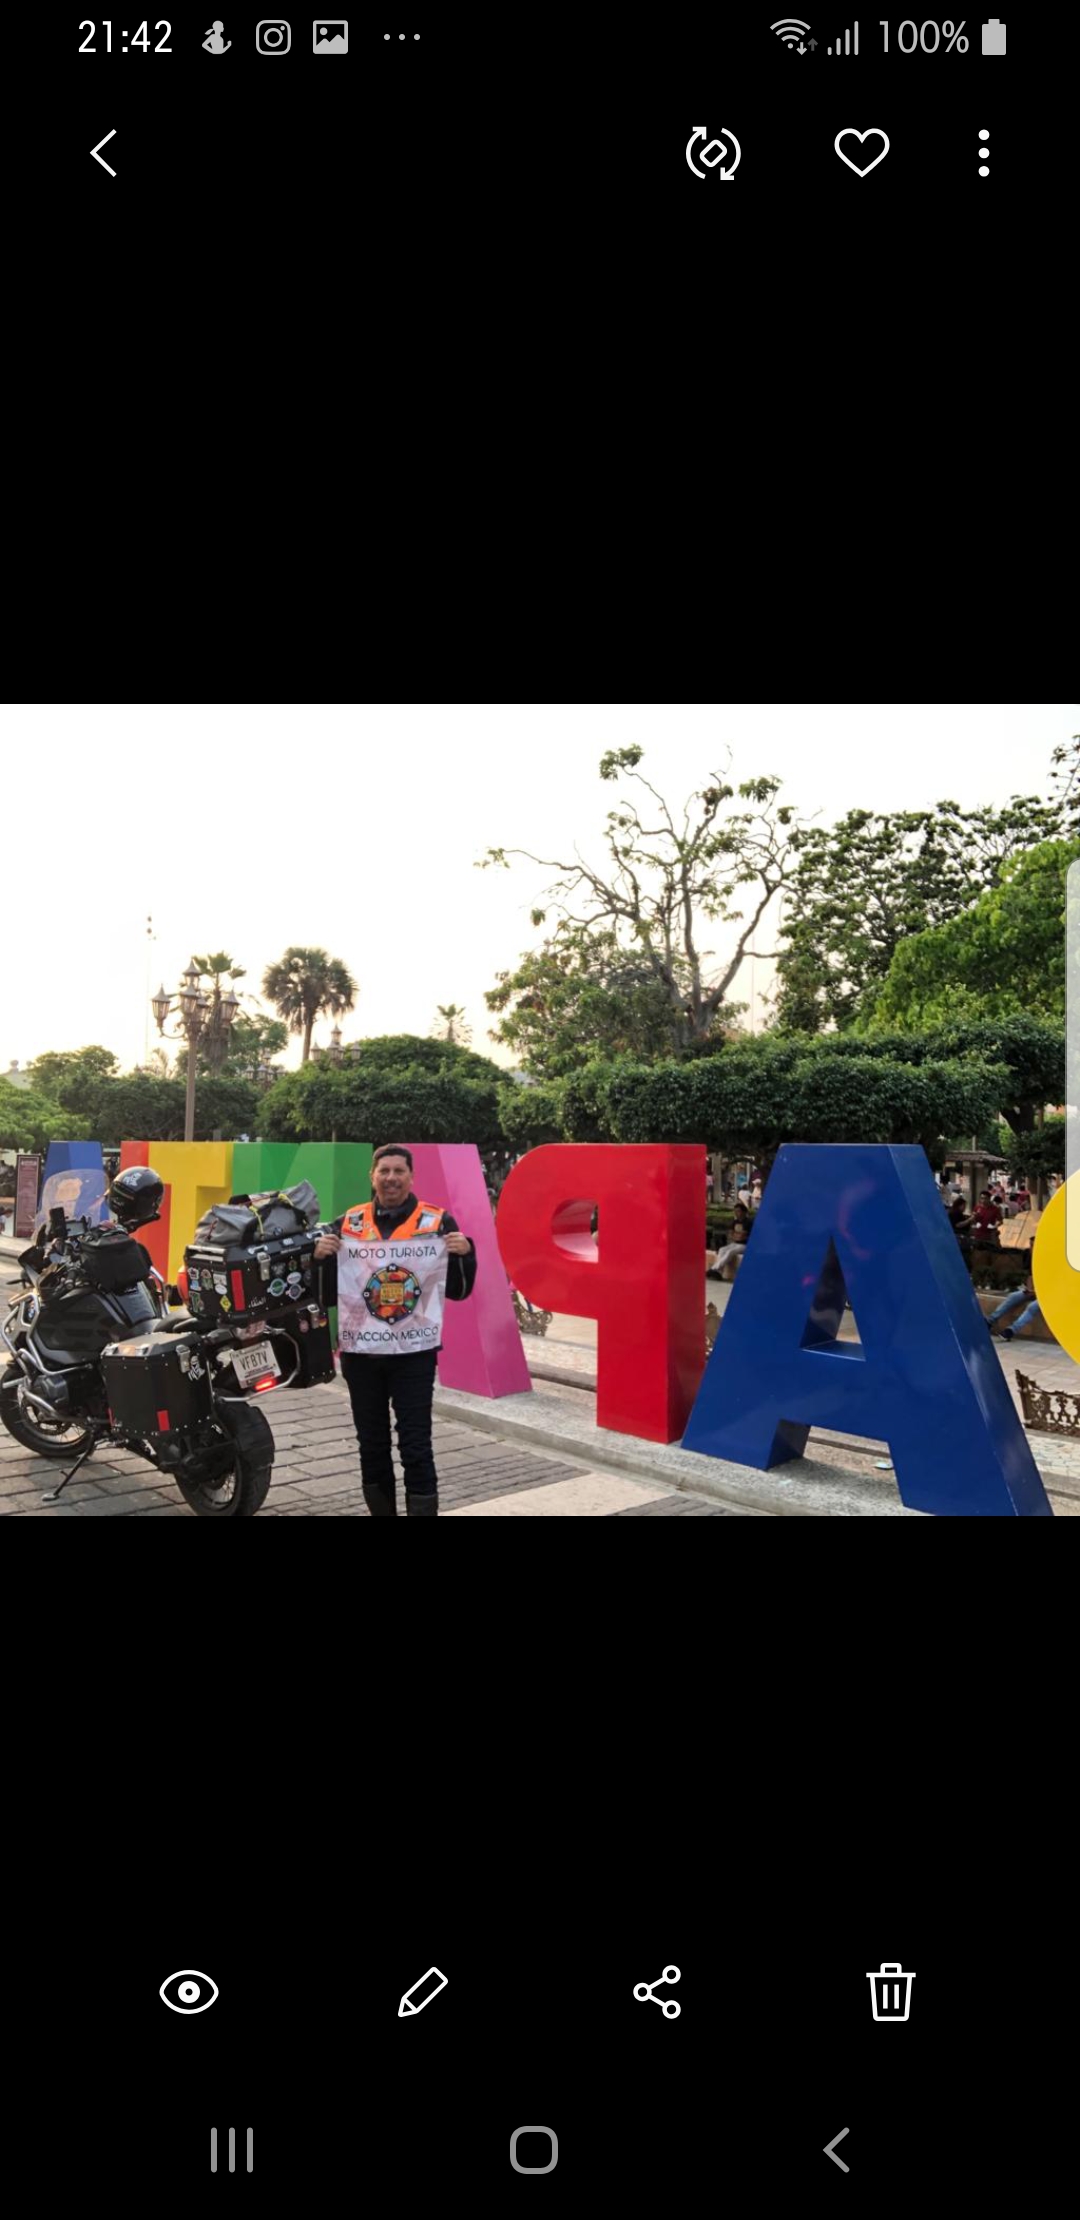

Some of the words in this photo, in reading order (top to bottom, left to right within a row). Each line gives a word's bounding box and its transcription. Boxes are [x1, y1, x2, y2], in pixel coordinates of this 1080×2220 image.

[348, 1248, 386, 1259] MOTO
[389, 1246, 437, 1259] TURISTA
[342, 1330, 354, 1341] EN
[357, 1329, 398, 1342] ACCIÓN
[400, 1326, 439, 1340] MÉXICO
